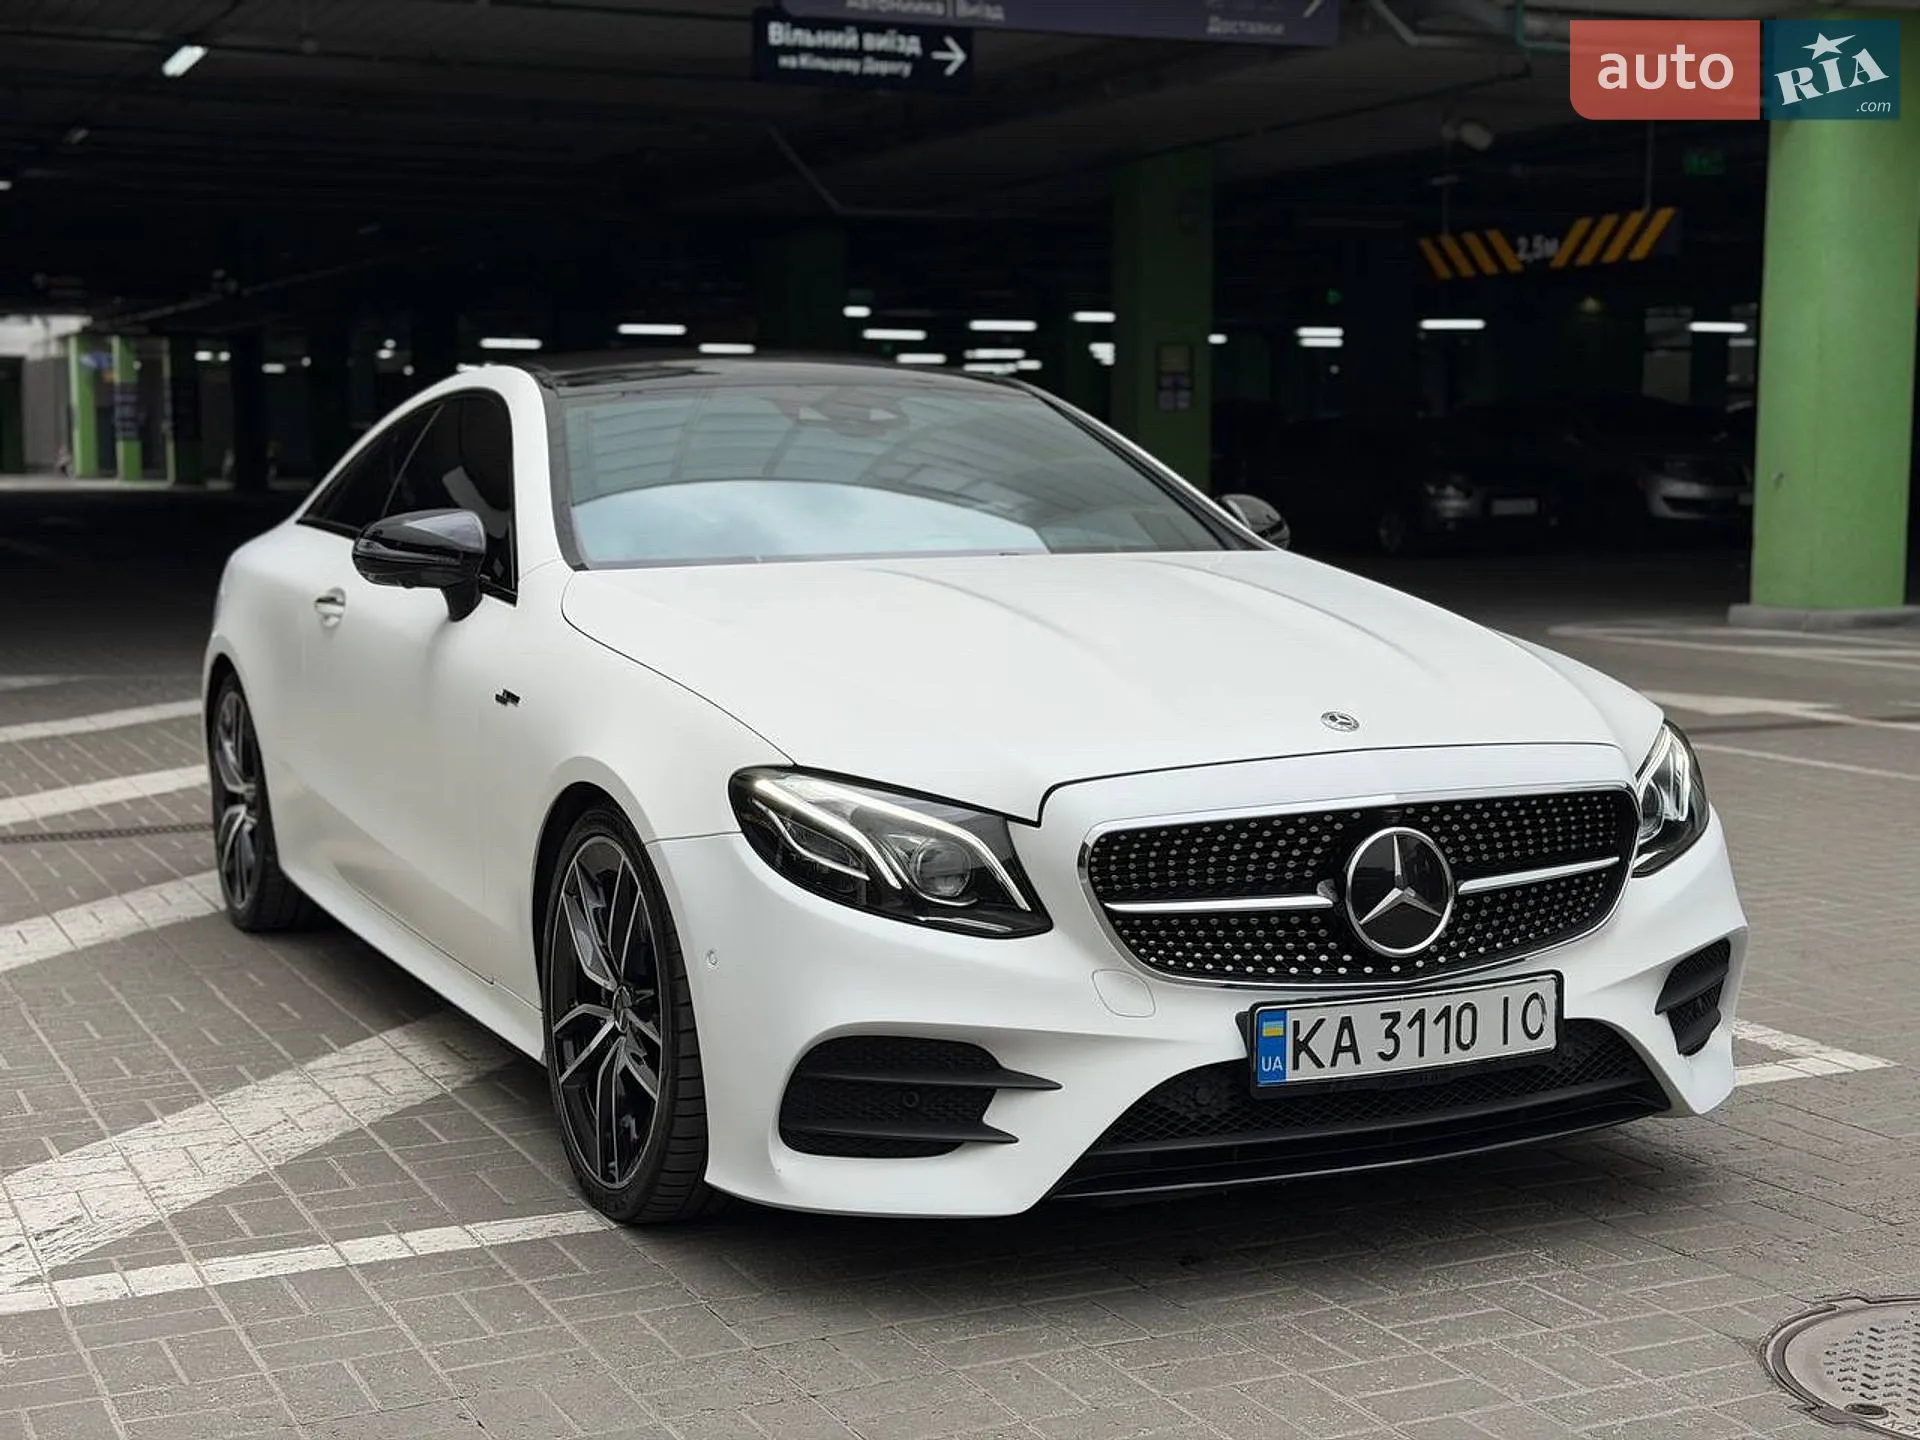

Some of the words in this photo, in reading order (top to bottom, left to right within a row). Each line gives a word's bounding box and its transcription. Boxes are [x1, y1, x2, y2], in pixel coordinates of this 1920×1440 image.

[768, 21, 859, 50] Вільний
[1292, 1015, 1361, 1071] KA
[1376, 1002, 1478, 1062] 3110
[1261, 1056, 1284, 1073] UA
